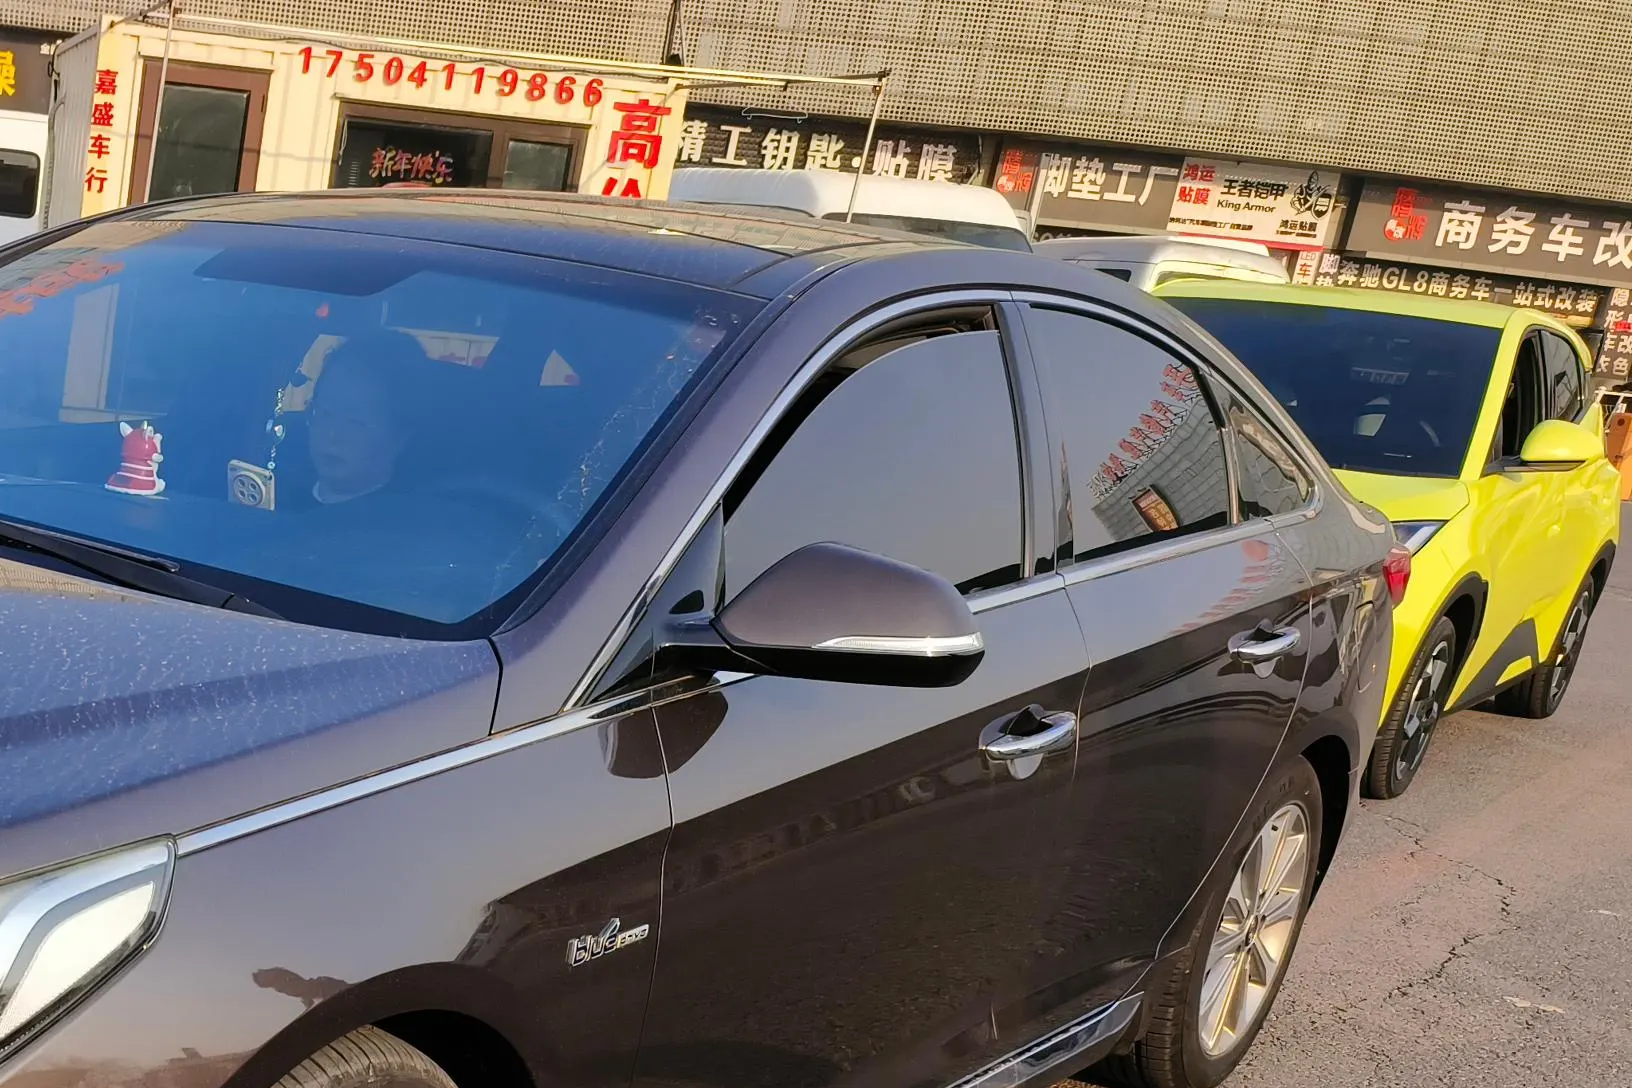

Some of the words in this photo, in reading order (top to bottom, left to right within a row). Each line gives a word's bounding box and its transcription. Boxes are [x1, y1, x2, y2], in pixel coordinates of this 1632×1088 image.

[299, 46, 603, 107] 17504119866
[84, 69, 119, 193] 嘉盛车行
[369, 147, 453, 183] 新年快乐
[1042, 152, 1179, 206] 脚垫工厂
[1183, 163, 1215, 183] 鸿运
[1177, 186, 1211, 206] 贴膜
[1217, 199, 1241, 212] King
[1244, 202, 1277, 213] Armor
[1220, 178, 1289, 201] 王者铠甲
[1434, 200, 1632, 270] 商务车改
[1338, 259, 1597, 313] 奔驰GL8商务车一站式改装
